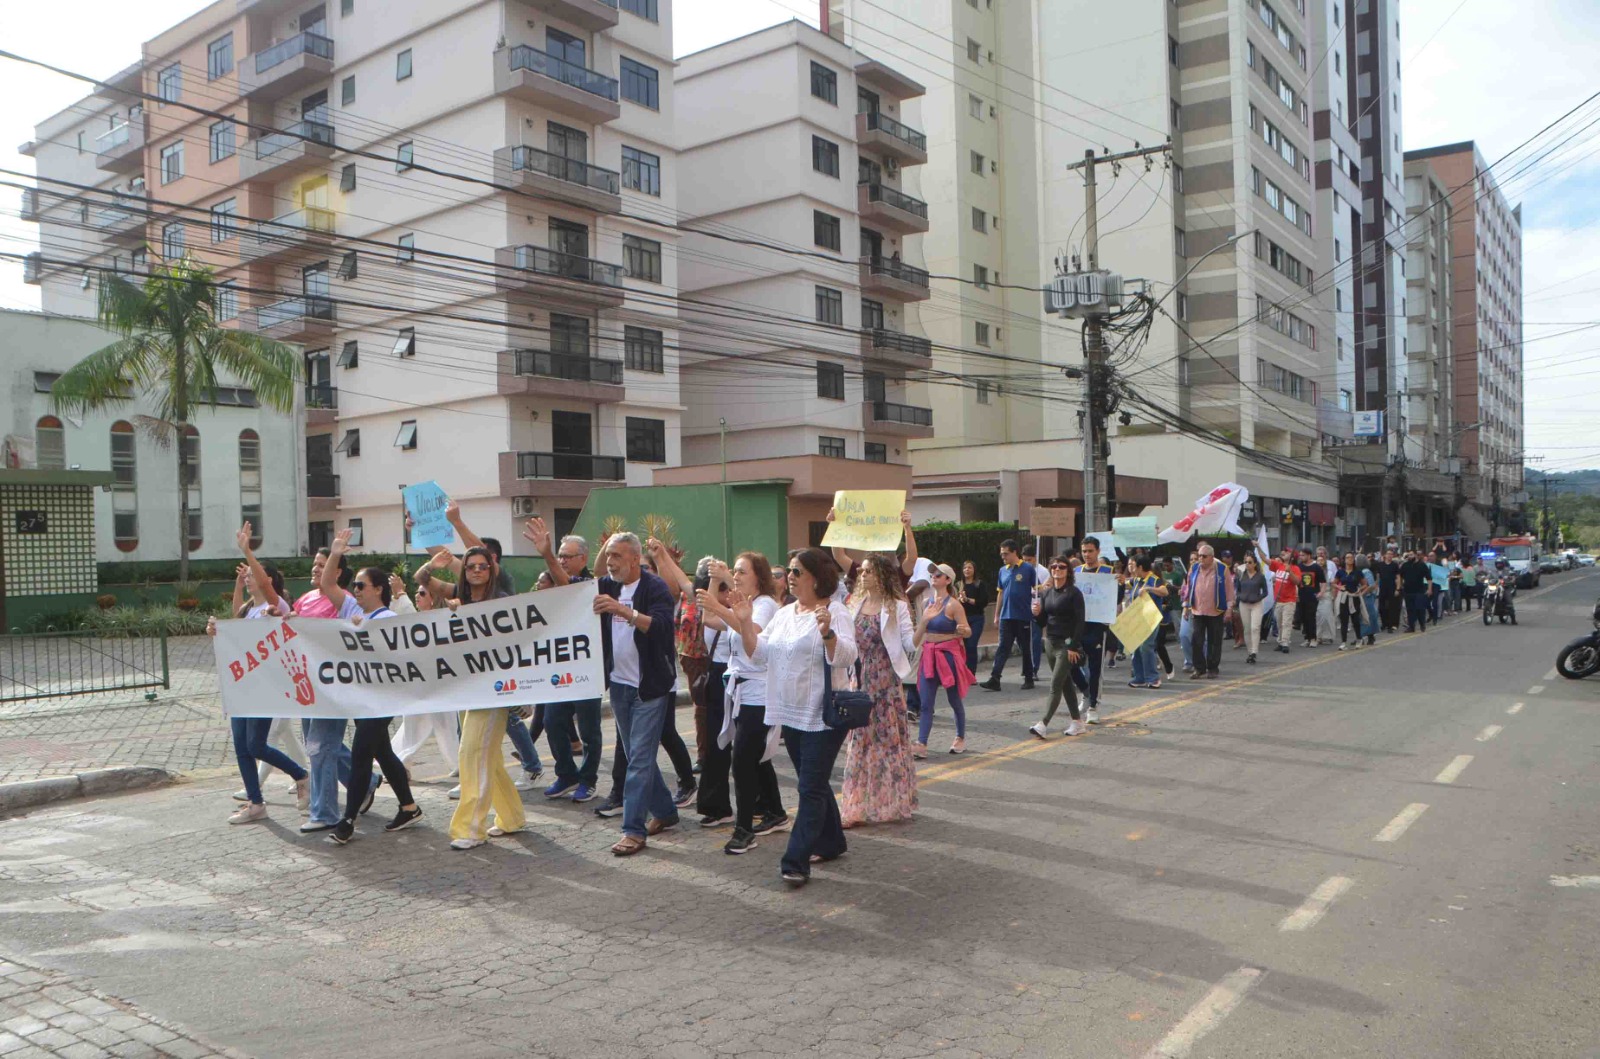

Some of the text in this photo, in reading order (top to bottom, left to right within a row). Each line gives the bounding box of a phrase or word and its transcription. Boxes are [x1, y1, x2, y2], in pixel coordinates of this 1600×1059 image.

[20, 513, 45, 531] 275
[340, 604, 549, 652] DE VIOLÊNCIA
[228, 622, 298, 682] BASTA
[317, 635, 592, 685] CONTRA A MULHER
[494, 678, 517, 692] OAB
[551, 672, 573, 686] OAB
